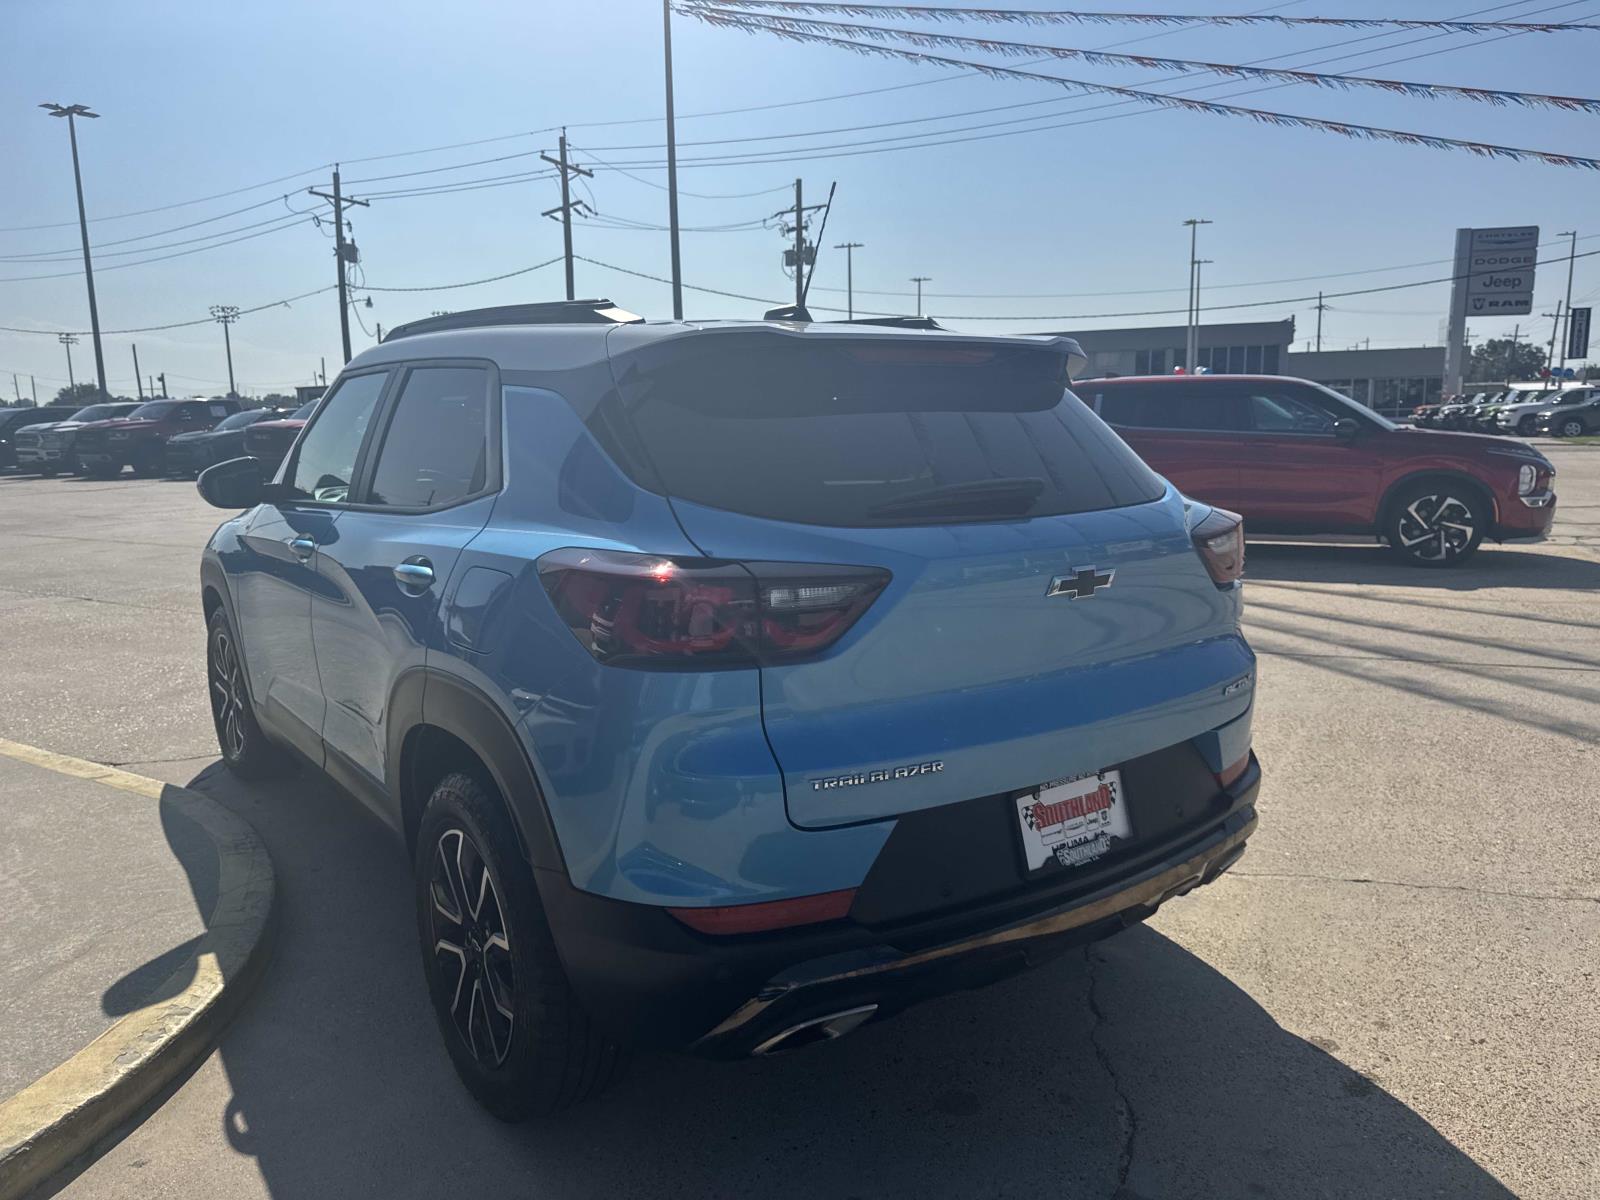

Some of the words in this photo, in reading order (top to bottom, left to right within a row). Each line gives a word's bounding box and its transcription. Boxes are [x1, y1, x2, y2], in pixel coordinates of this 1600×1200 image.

[1474, 256, 1533, 266] DODGE
[1482, 275, 1522, 289] Jeep
[1488, 299, 1530, 308] RAM
[809, 760, 945, 791] TRAILBLAZER
